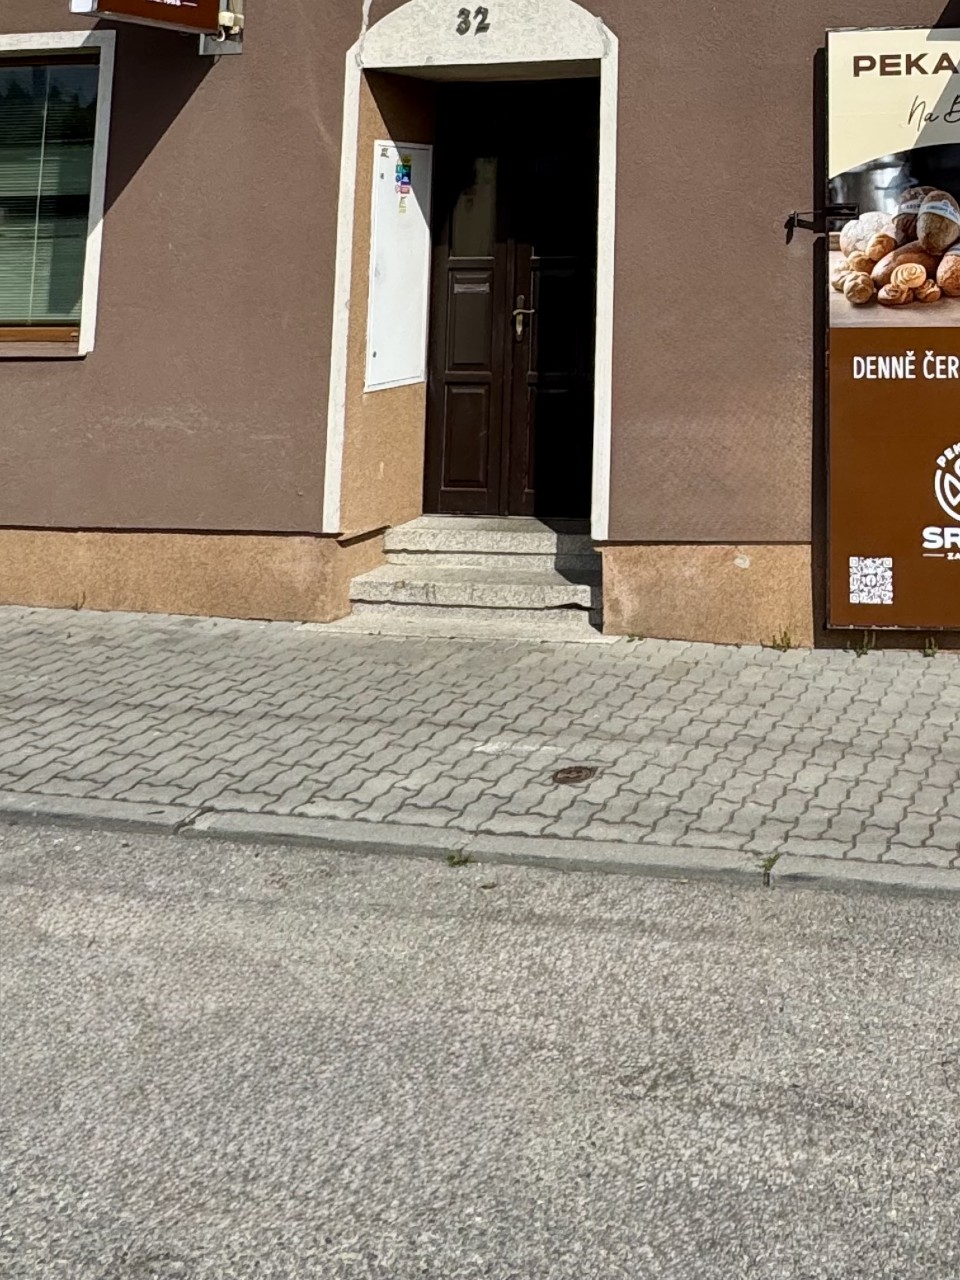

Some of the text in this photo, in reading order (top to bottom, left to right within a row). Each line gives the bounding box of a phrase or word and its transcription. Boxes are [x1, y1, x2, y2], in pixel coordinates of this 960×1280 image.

[455, 6, 491, 37] 32
[907, 95, 940, 132] Na
[852, 350, 917, 380] DENNĚ
